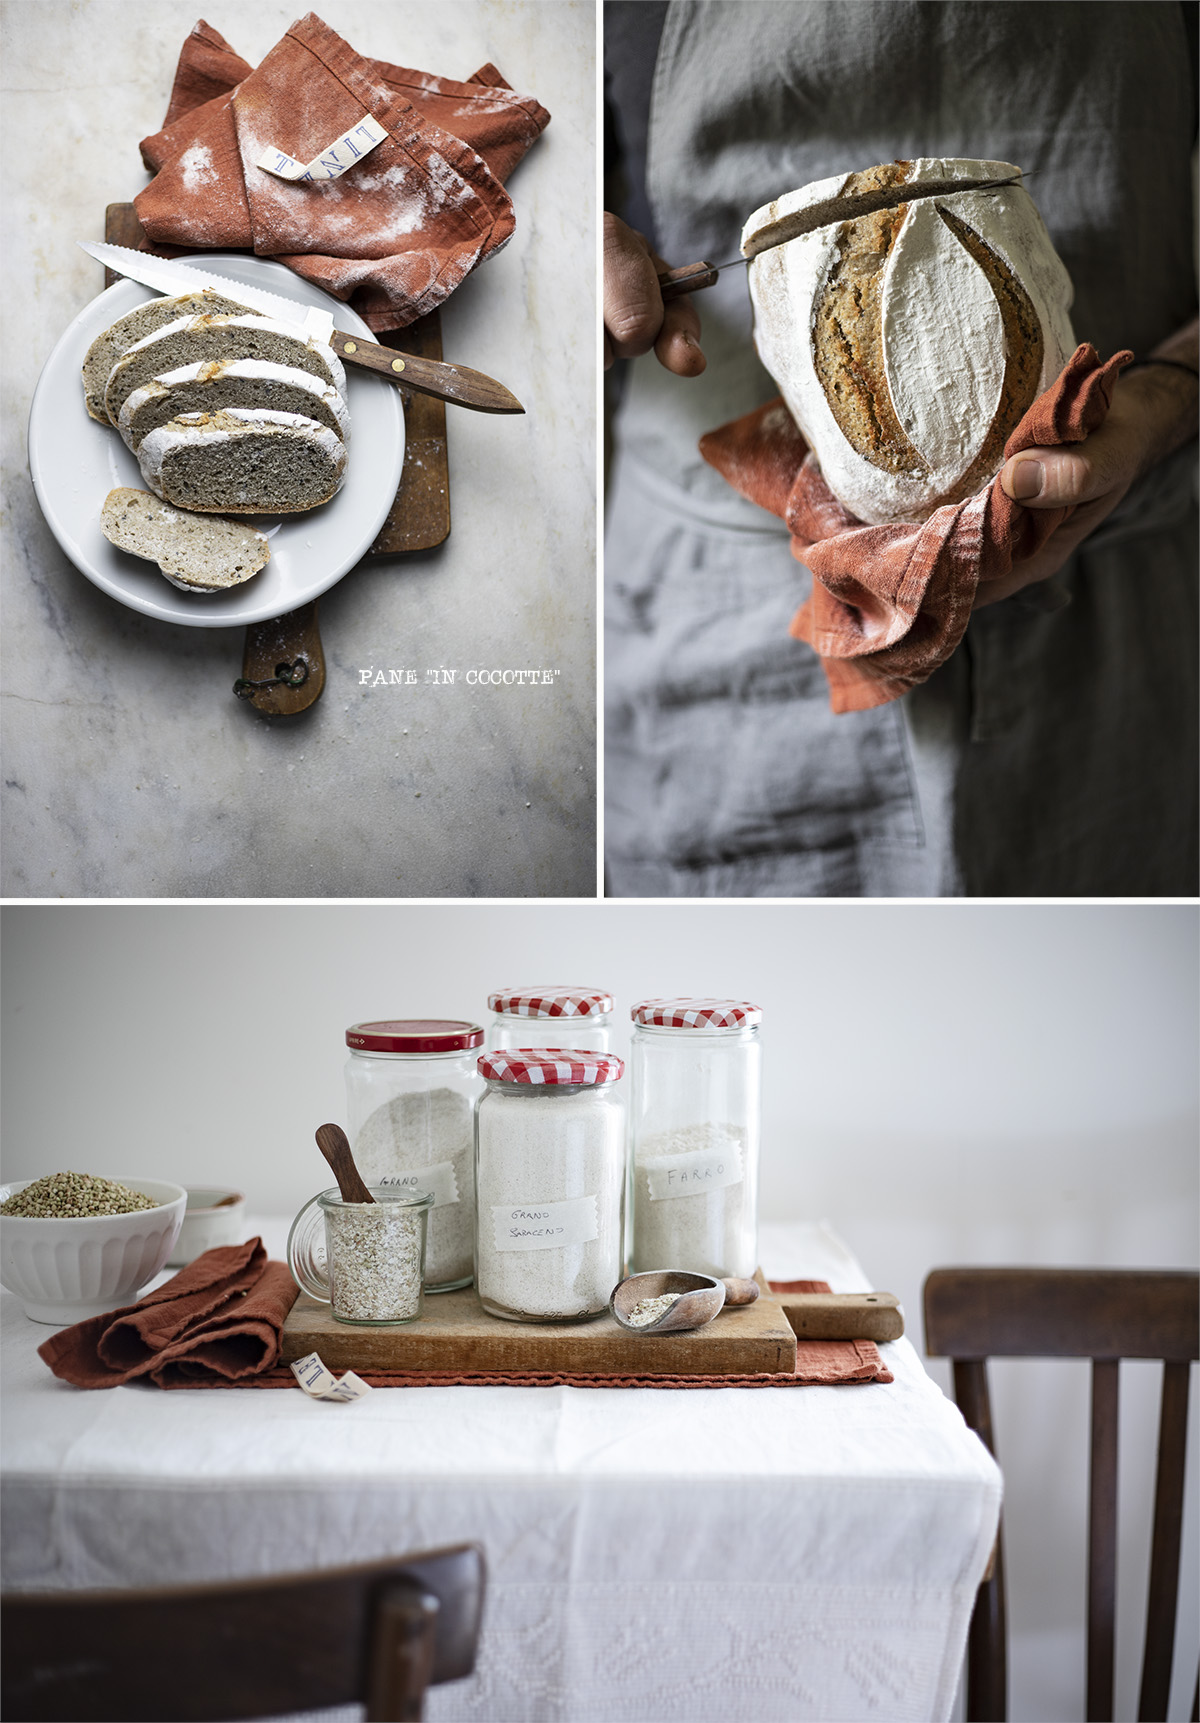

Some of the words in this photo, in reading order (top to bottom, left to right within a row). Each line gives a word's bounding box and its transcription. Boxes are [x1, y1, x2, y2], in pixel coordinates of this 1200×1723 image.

[667, 1164, 725, 1185] FARRO
[380, 1176, 419, 1187] GRANO
[511, 1209, 550, 1220] GRANO
[509, 1227, 564, 1238] SARACENO
